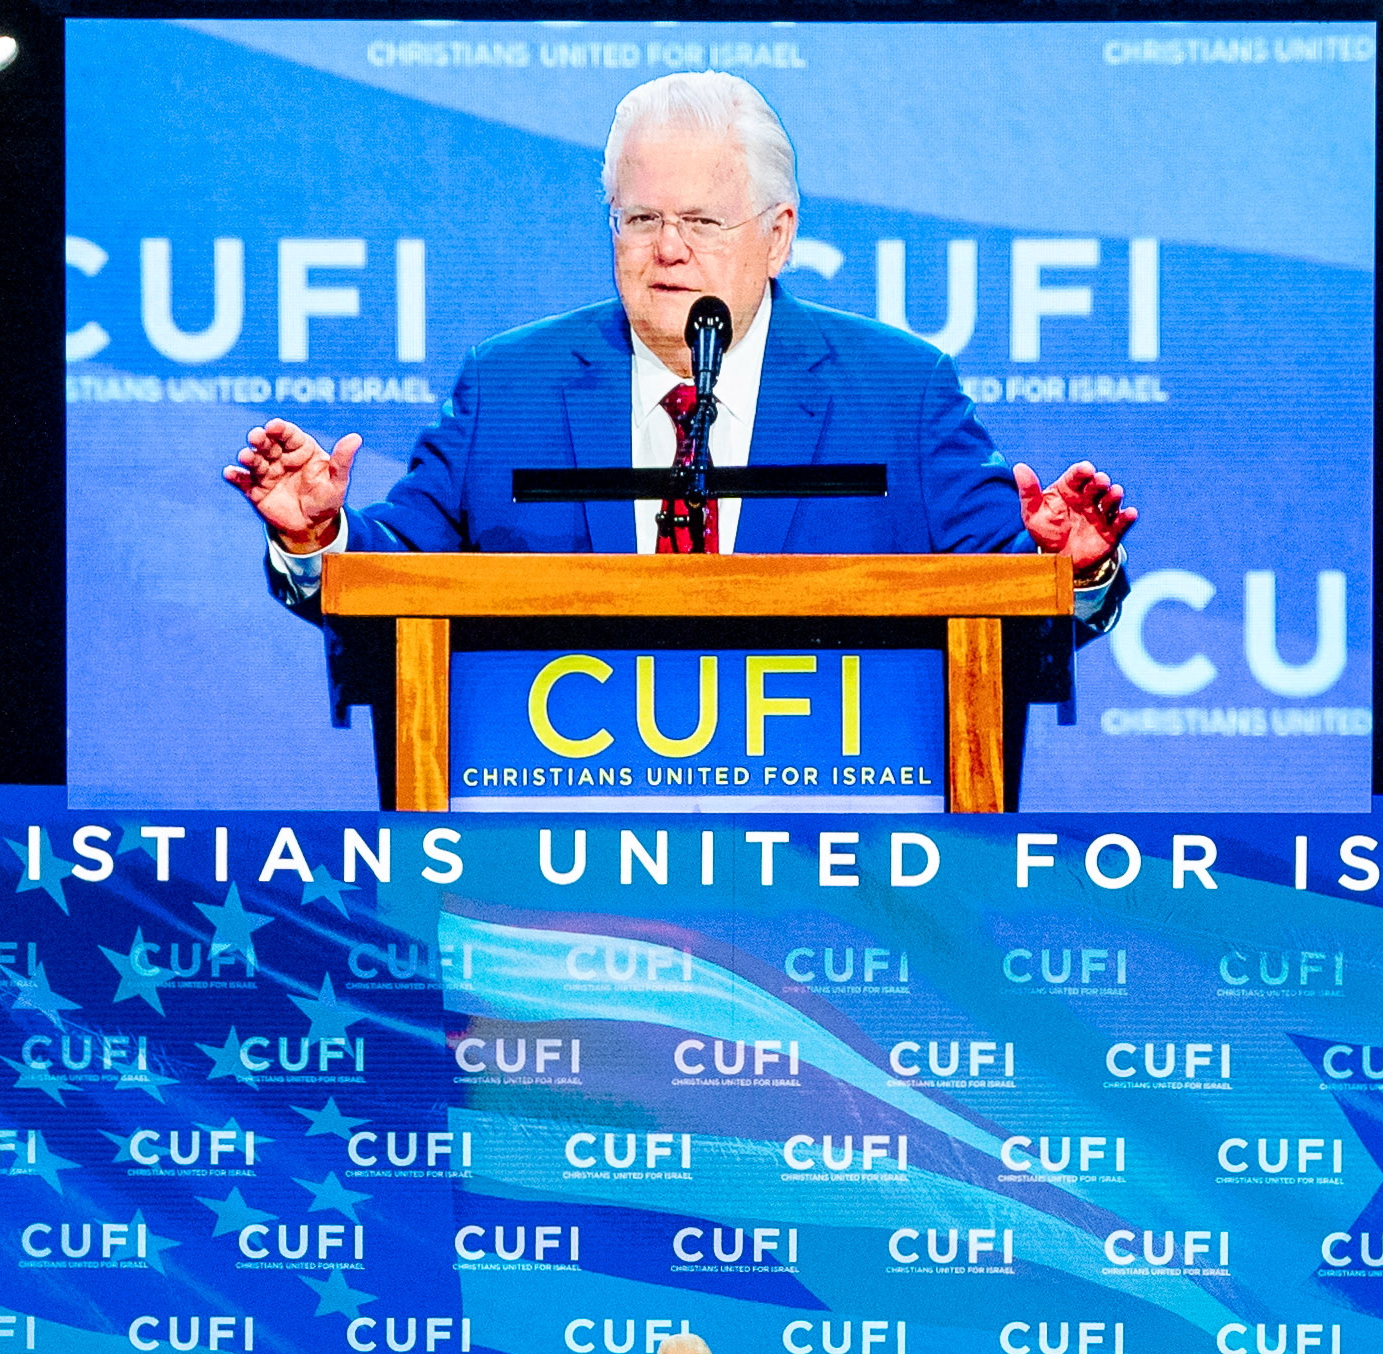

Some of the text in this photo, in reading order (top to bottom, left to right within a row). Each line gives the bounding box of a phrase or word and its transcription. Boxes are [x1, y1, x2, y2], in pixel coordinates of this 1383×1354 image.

[790, 238, 1160, 362] UFI
[528, 654, 860, 758] CUFI
[463, 766, 932, 786] CHRISTIANS UNITED FOR ISRAEL
[539, 829, 941, 888] UNITED
[1018, 833, 1218, 891] FOR
[130, 940, 255, 975] CUFI
[348, 943, 473, 978] CUFI
[566, 945, 691, 980] CUFI
[784, 947, 908, 982] CUFI
[1004, 949, 1126, 984] CUFI
[1220, 951, 1344, 986] CUFI
[22, 1035, 148, 1070] CUFI
[238, 1037, 364, 1072] CUFI
[456, 1038, 580, 1073] CUFI
[674, 1040, 800, 1075] CUFI
[889, 1041, 1014, 1076] CUFI
[1106, 1043, 1230, 1078] CUFI
[130, 1130, 254, 1165] CUFI
[348, 1132, 472, 1167] CUFI
[566, 1133, 690, 1168] CUFI
[782, 1135, 908, 1170] CUFI
[1000, 1136, 1125, 1171] CUFI
[1218, 1138, 1342, 1173] CUFI
[128, 1168, 175, 1176] CHRISTIANS
[177, 1168, 208, 1176] UNITED
[22, 1223, 146, 1258] CUFI
[238, 1224, 364, 1259] CUFI
[454, 1226, 578, 1261] CUFI
[674, 1227, 798, 1262] CUFI
[888, 1229, 1014, 1264] CUFI
[1104, 1230, 1228, 1265] CUFI
[128, 1316, 254, 1351] CUFI
[346, 1318, 470, 1353] CUFI
